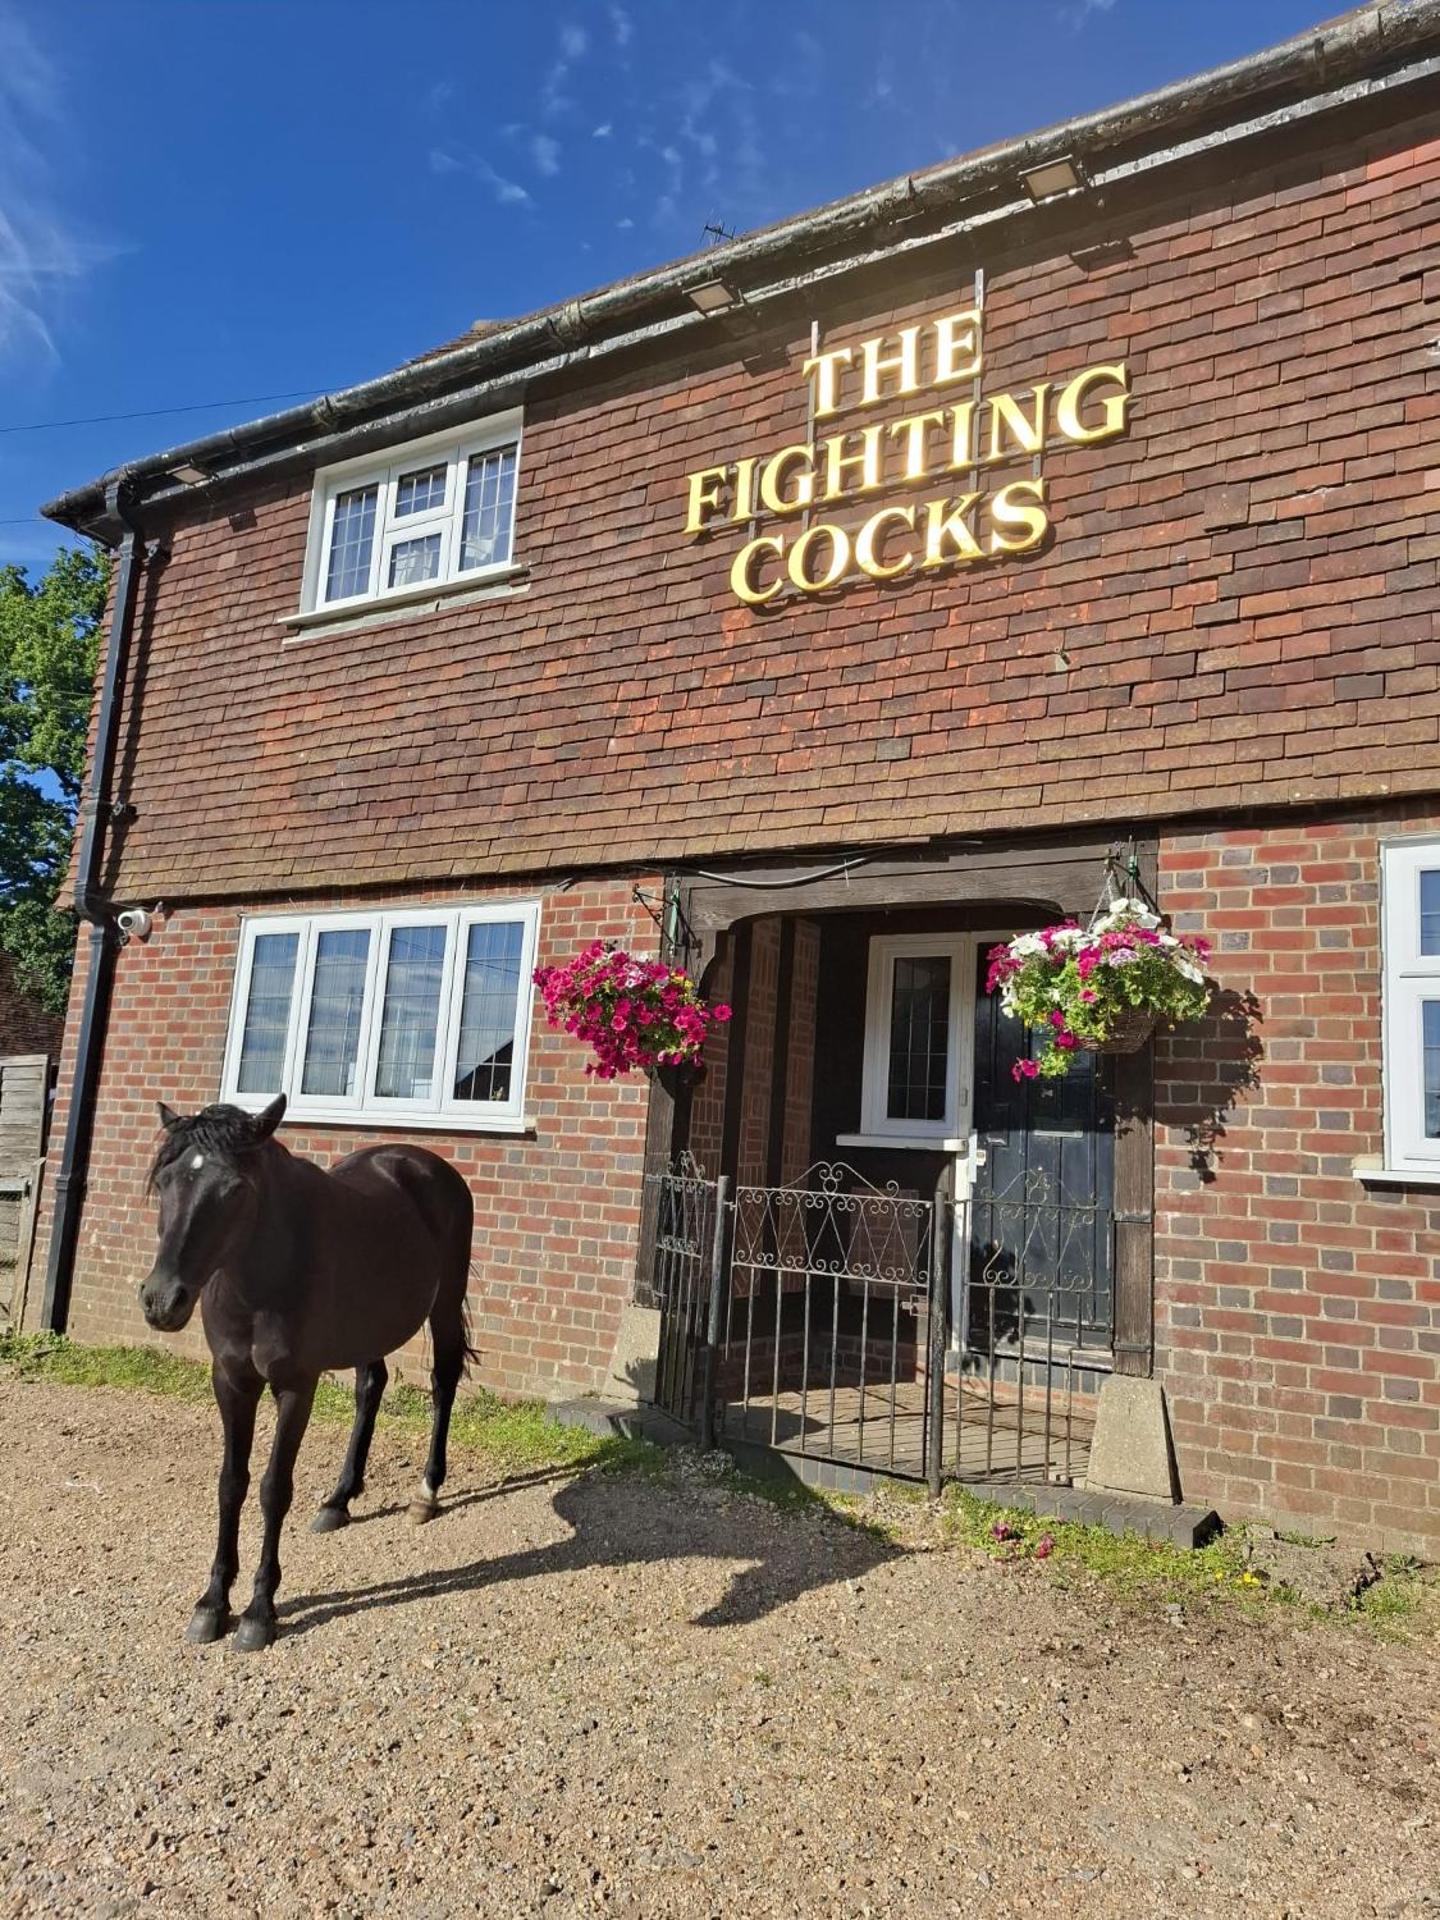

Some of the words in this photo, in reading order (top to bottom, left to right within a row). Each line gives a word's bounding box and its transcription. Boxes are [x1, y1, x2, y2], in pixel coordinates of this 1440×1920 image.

[803, 309, 983, 420] THE
[683, 363, 1133, 535] FIGHTING
[730, 478, 1049, 606] COCKS
